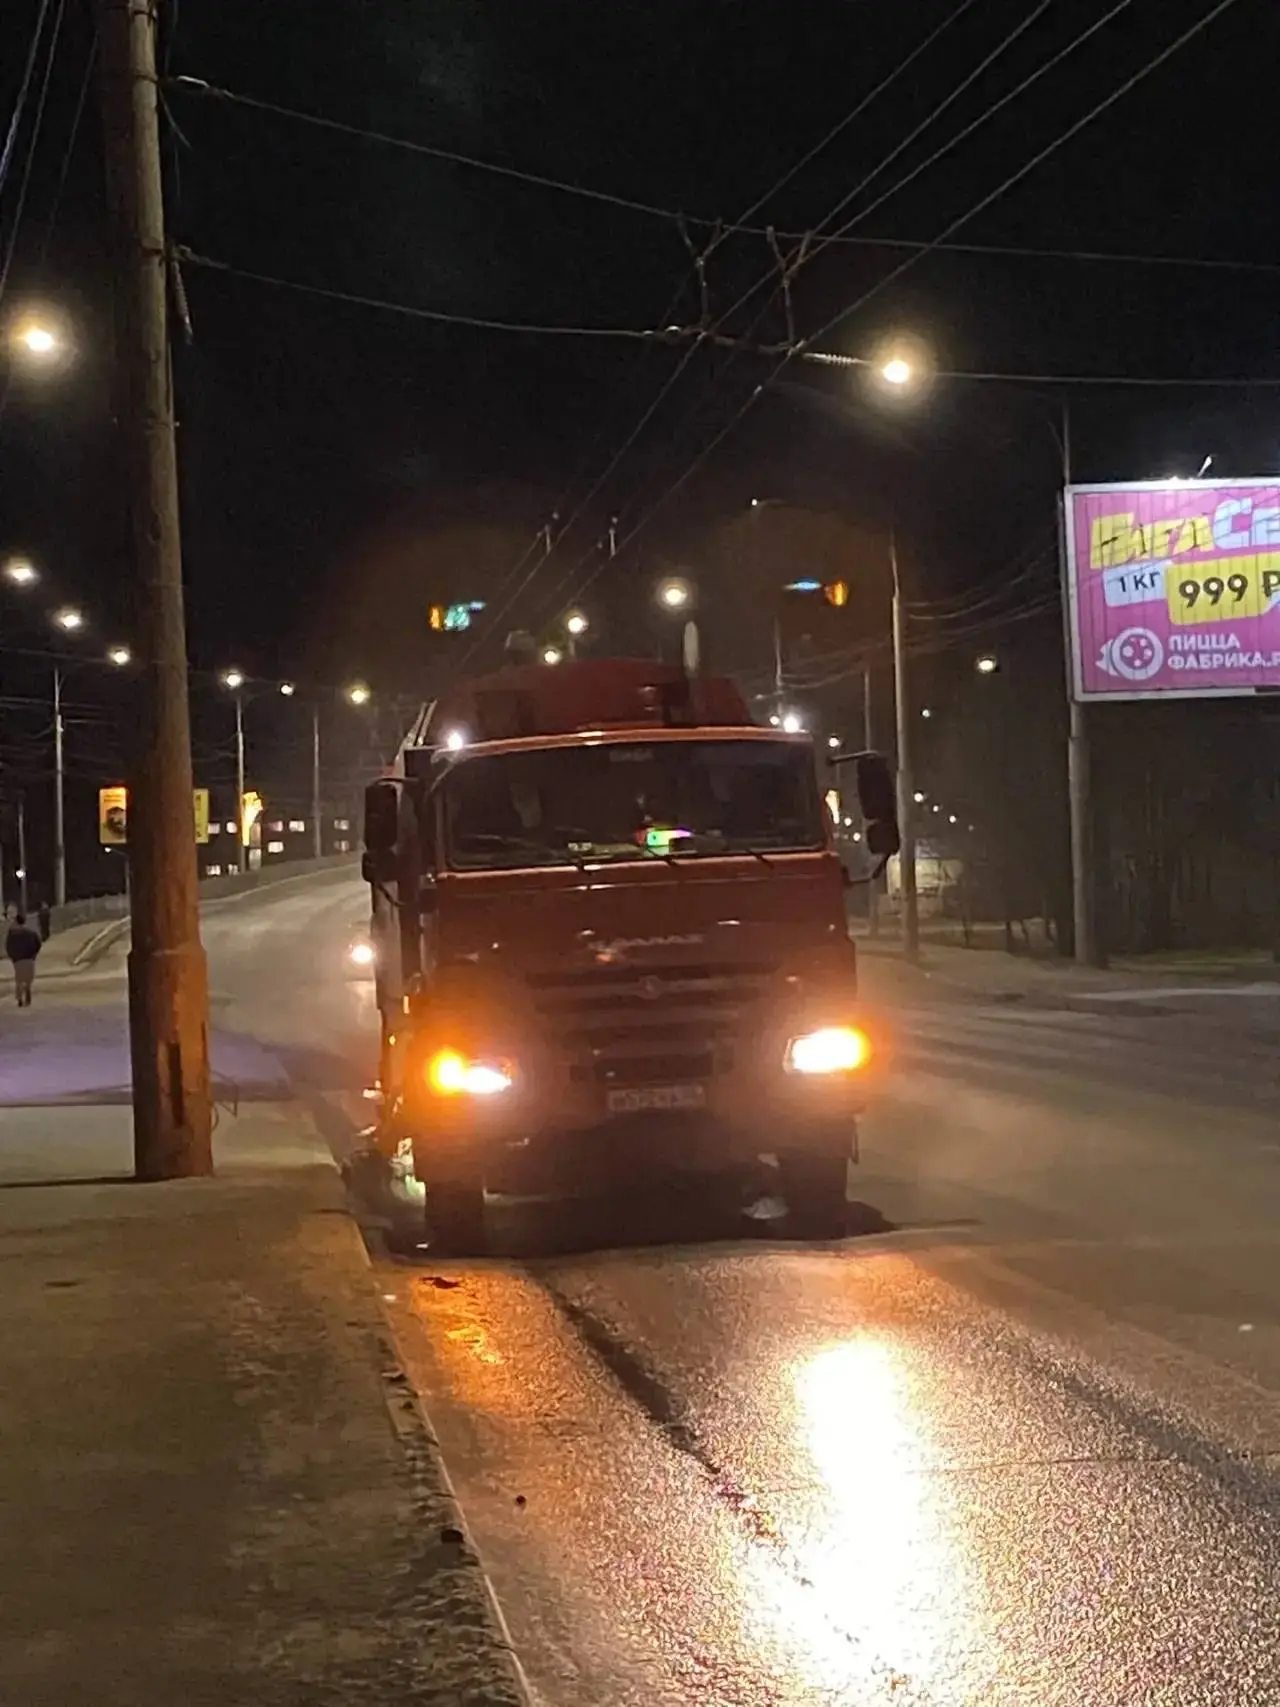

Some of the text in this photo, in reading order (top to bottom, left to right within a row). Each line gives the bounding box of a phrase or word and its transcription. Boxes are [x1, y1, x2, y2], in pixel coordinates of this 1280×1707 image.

[1119, 576, 1126, 593] 1
[1179, 574, 1248, 608] 999
[1169, 633, 1240, 651] ПИЦЦА
